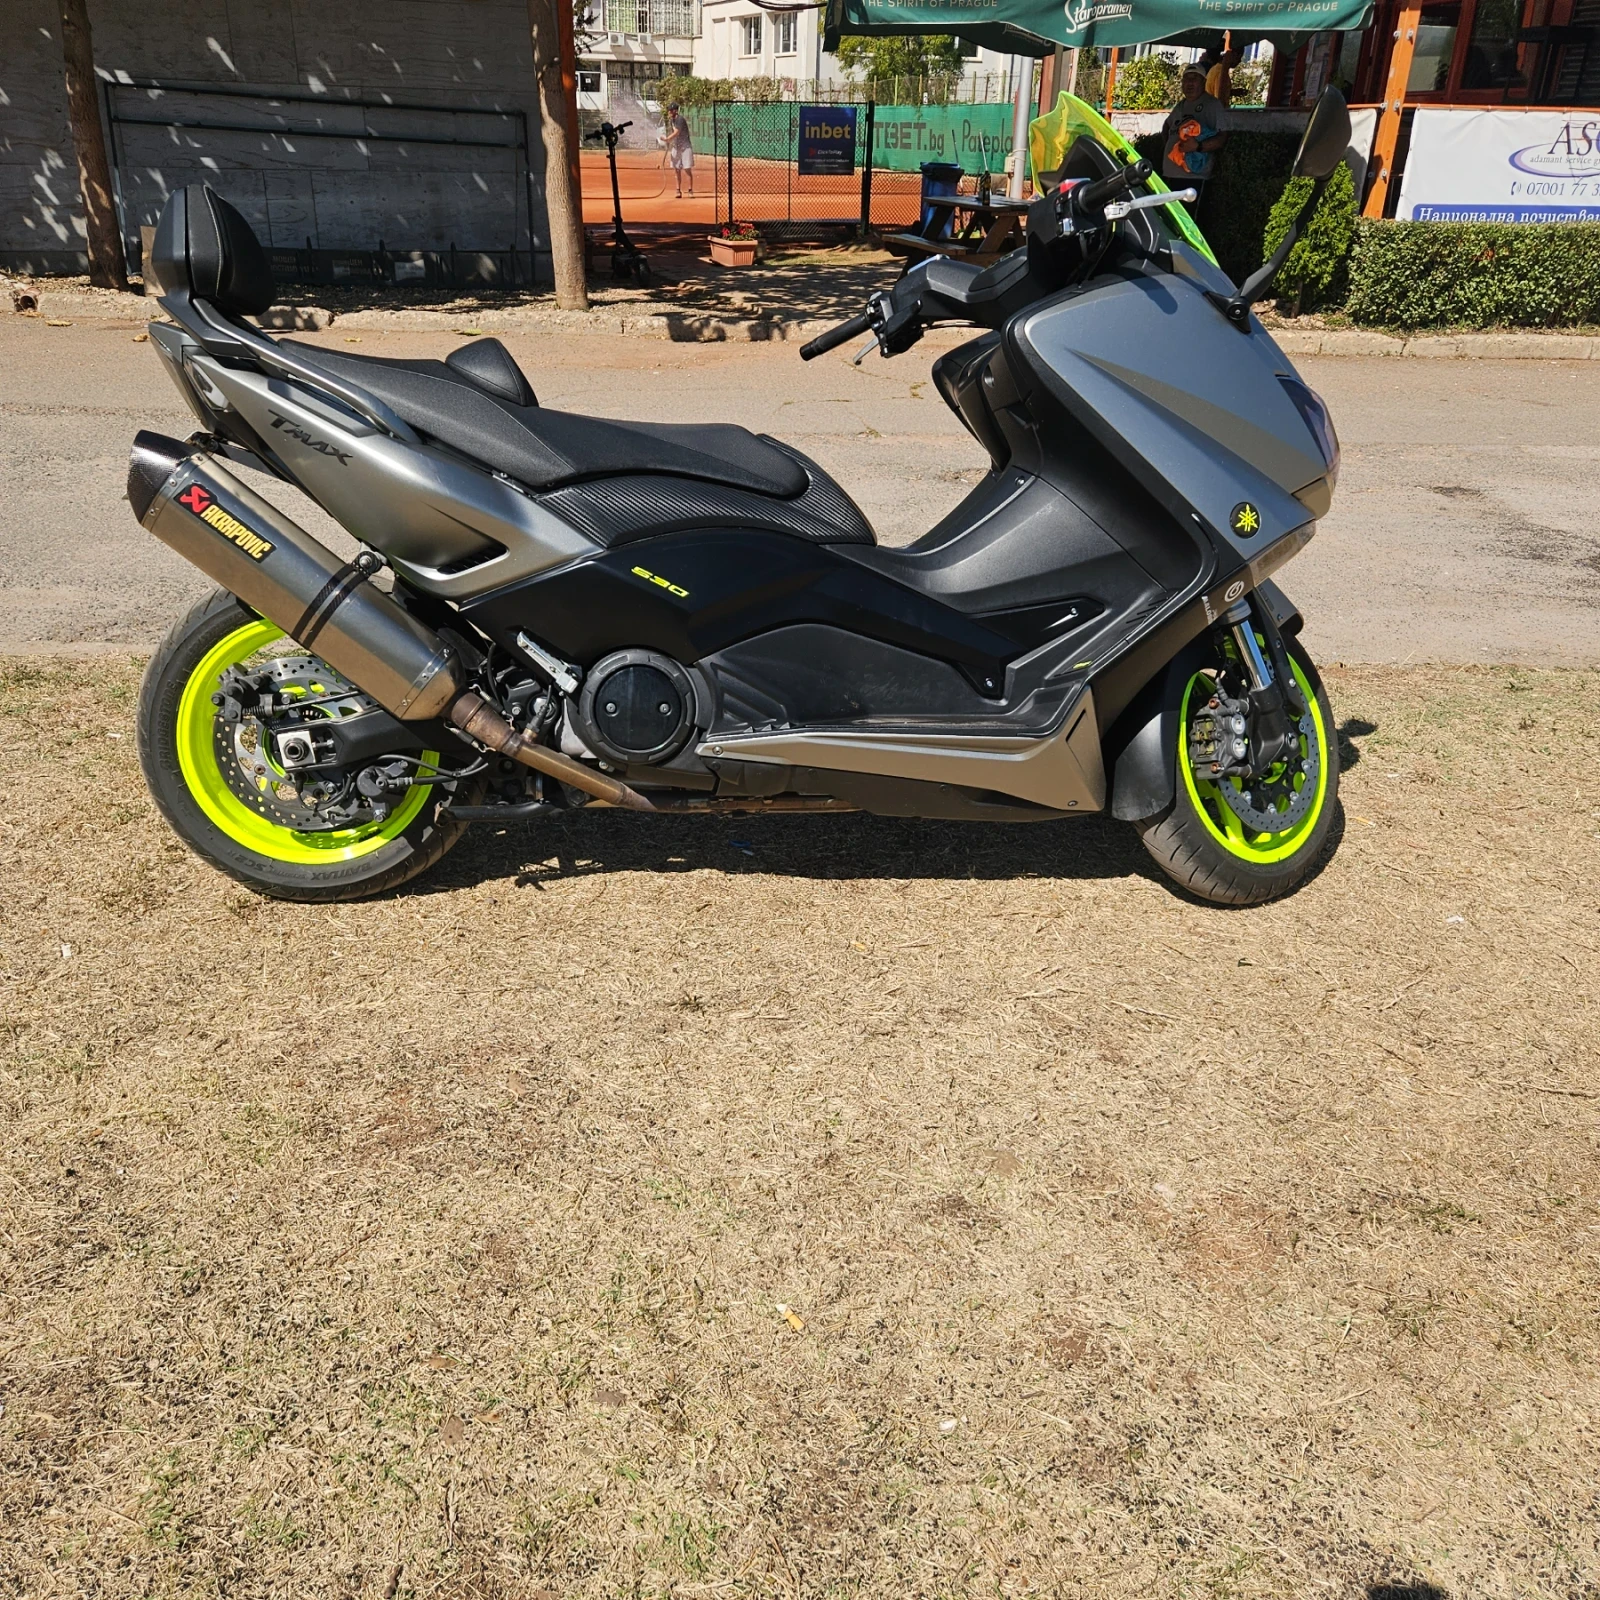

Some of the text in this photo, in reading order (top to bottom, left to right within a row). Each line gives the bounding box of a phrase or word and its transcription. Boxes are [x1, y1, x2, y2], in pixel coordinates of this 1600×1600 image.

[888, 0, 925, 8] SPIRIT
[1198, 1, 1339, 12] THE SPIRIT OF PRAGUE
[1064, 0, 1133, 34] Staropramen
[805, 120, 851, 140] inbet
[1547, 121, 1600, 157] AS
[961, 118, 1014, 161] Patepla
[1529, 154, 1563, 164] adamant
[1565, 155, 1592, 164] service
[1526, 182, 1600, 197] 07001 77 3
[1418, 207, 1514, 223] Национална
[630, 566, 690, 598] 530
